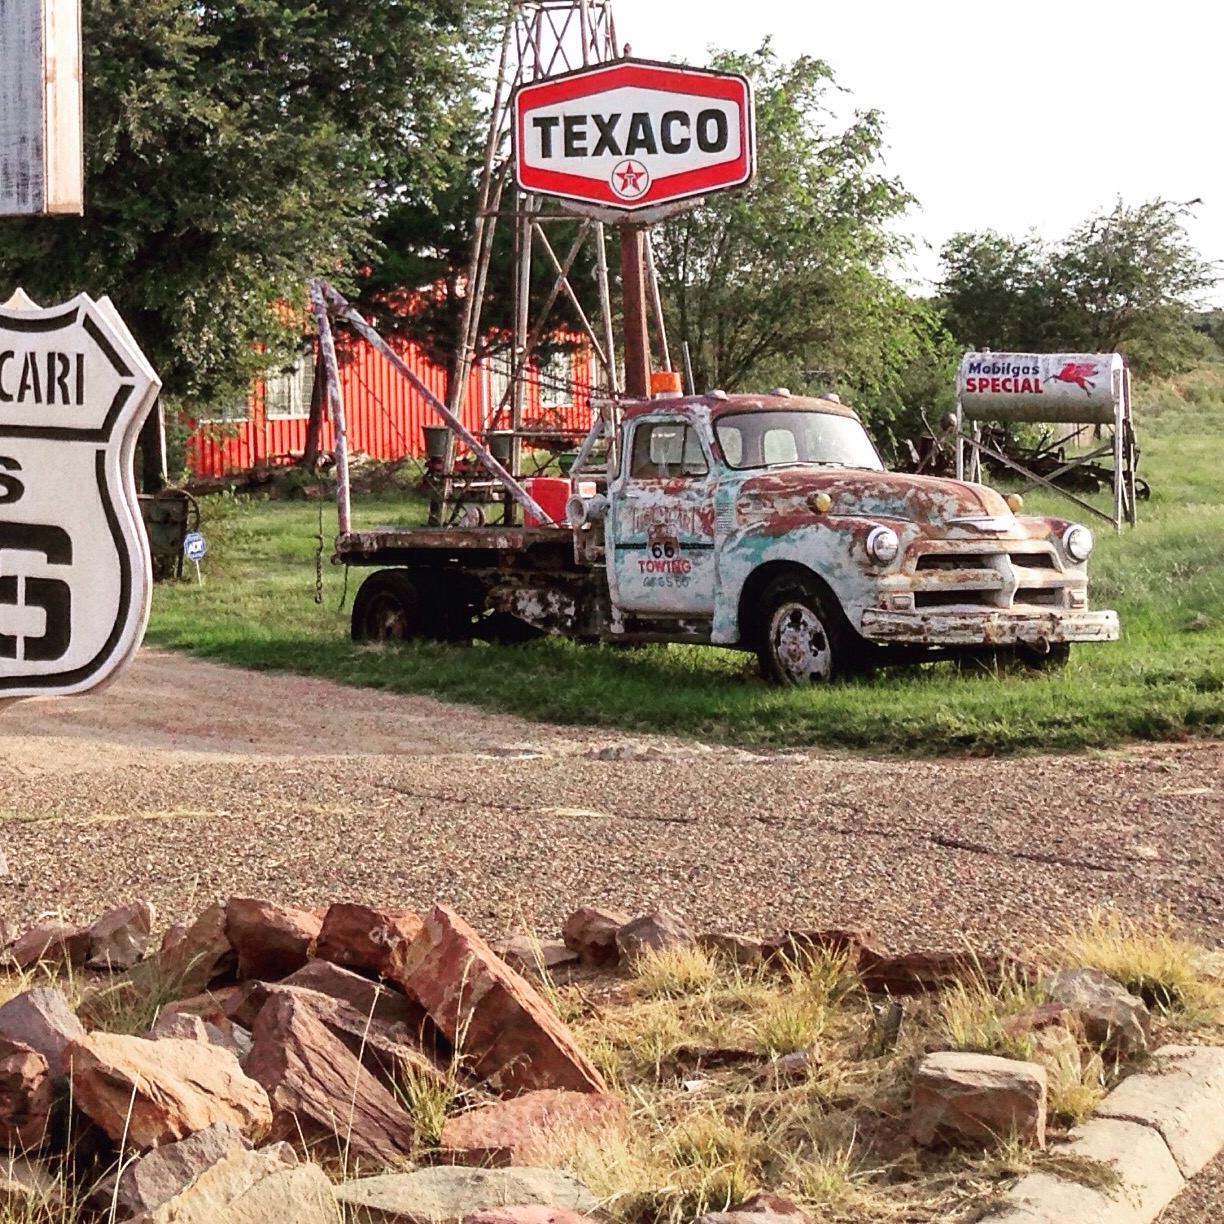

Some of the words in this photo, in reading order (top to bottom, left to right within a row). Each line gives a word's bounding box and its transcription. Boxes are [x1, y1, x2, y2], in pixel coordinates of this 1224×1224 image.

[532, 109, 728, 158] TEXACO
[968, 362, 1040, 377] Mobilgas
[966, 378, 1043, 394] SPECIAL
[651, 542, 675, 559] 66
[638, 559, 692, 574] TOWING
